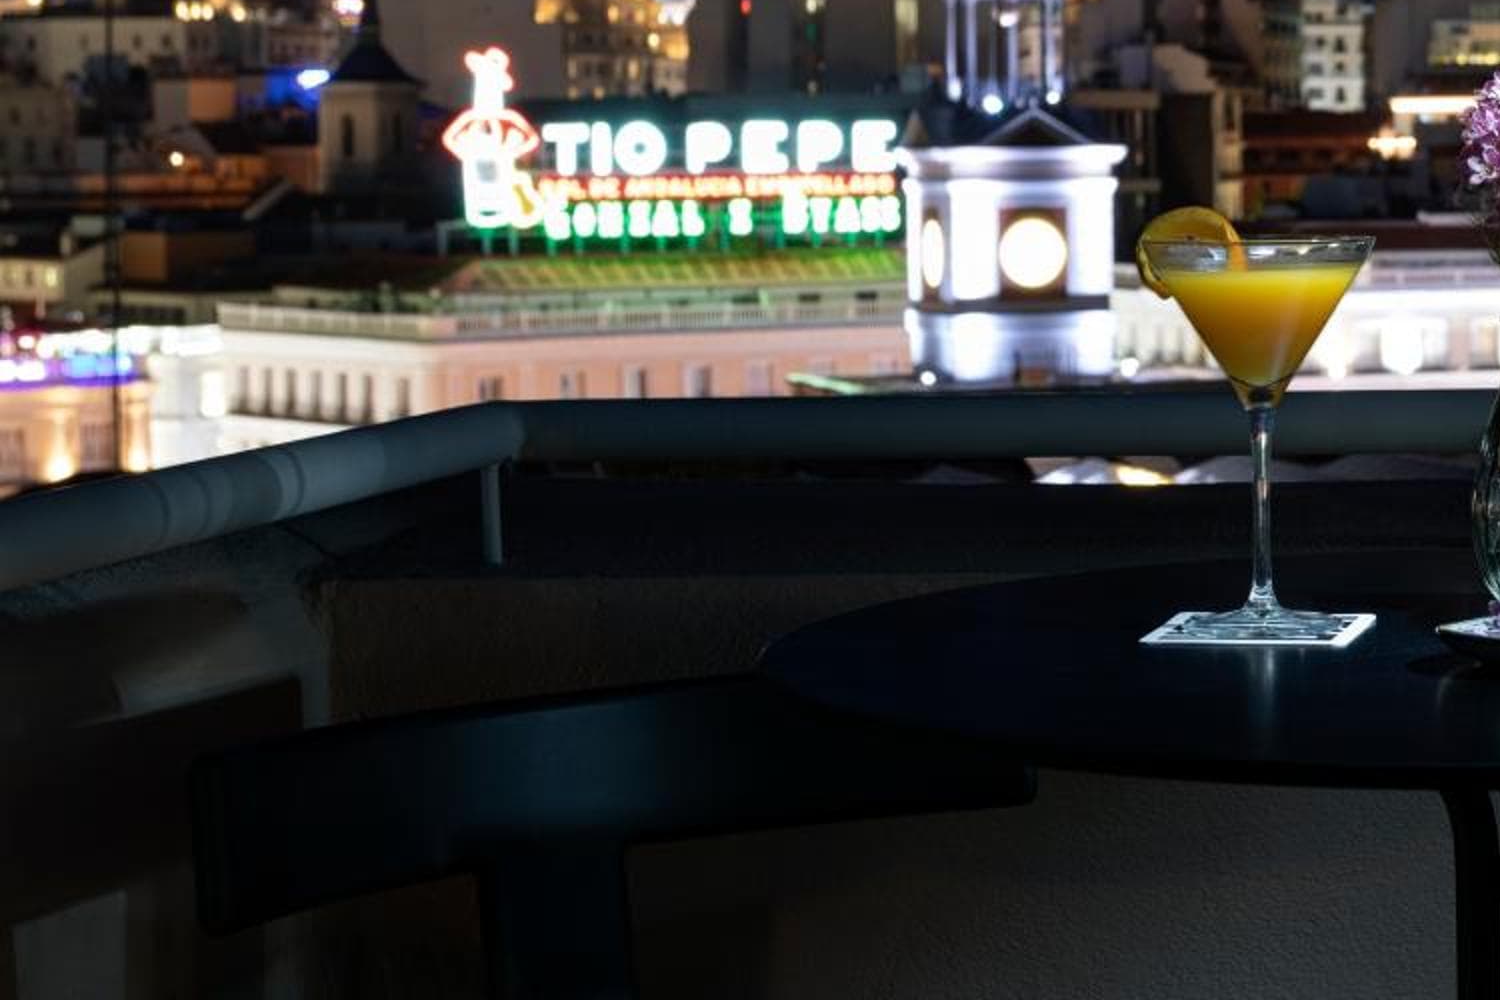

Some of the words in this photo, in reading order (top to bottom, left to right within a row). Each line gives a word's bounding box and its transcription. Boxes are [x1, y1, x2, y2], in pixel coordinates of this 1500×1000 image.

[541, 120, 667, 176] TIO
[686, 119, 898, 173] PEPE
[543, 180, 752, 239] GONZALZ
[588, 175, 619, 199] DE
